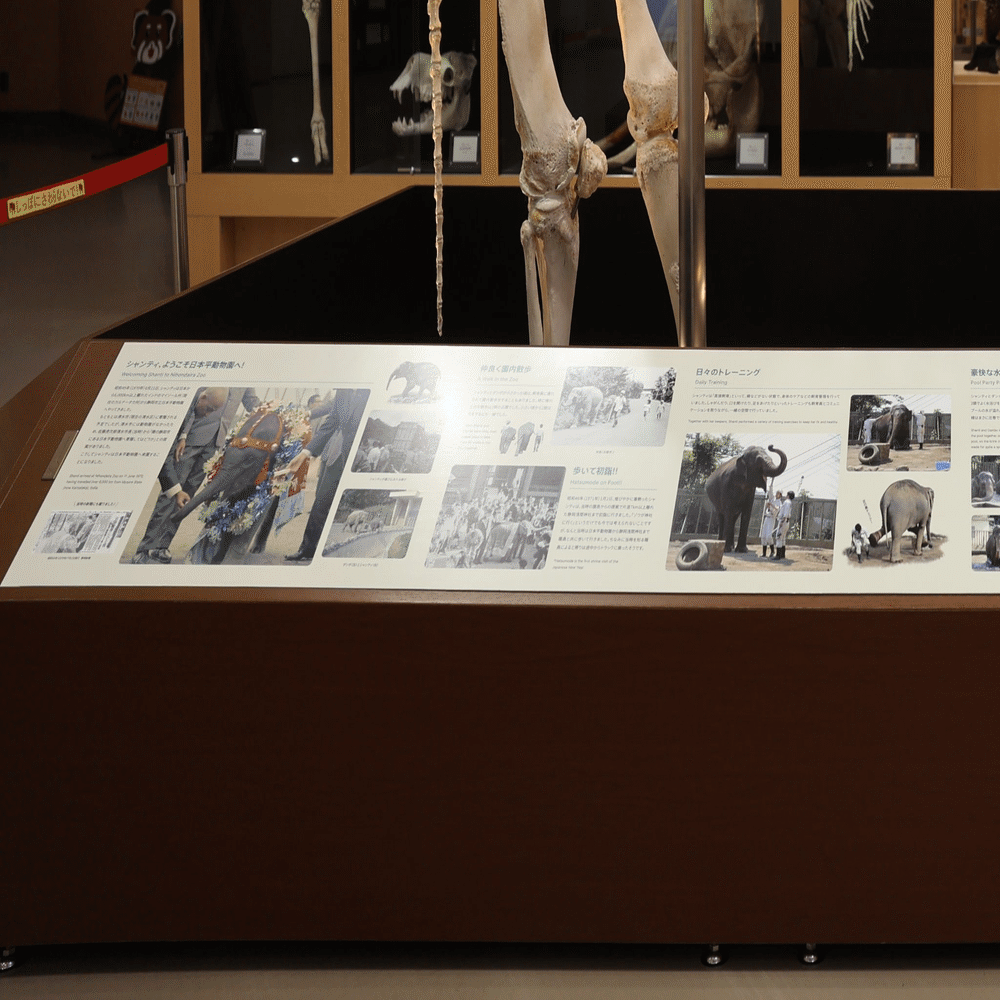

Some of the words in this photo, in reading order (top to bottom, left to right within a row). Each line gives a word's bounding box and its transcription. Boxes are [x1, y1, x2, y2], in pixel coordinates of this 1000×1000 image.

[695, 368, 761, 376] 日々のトレーニング
